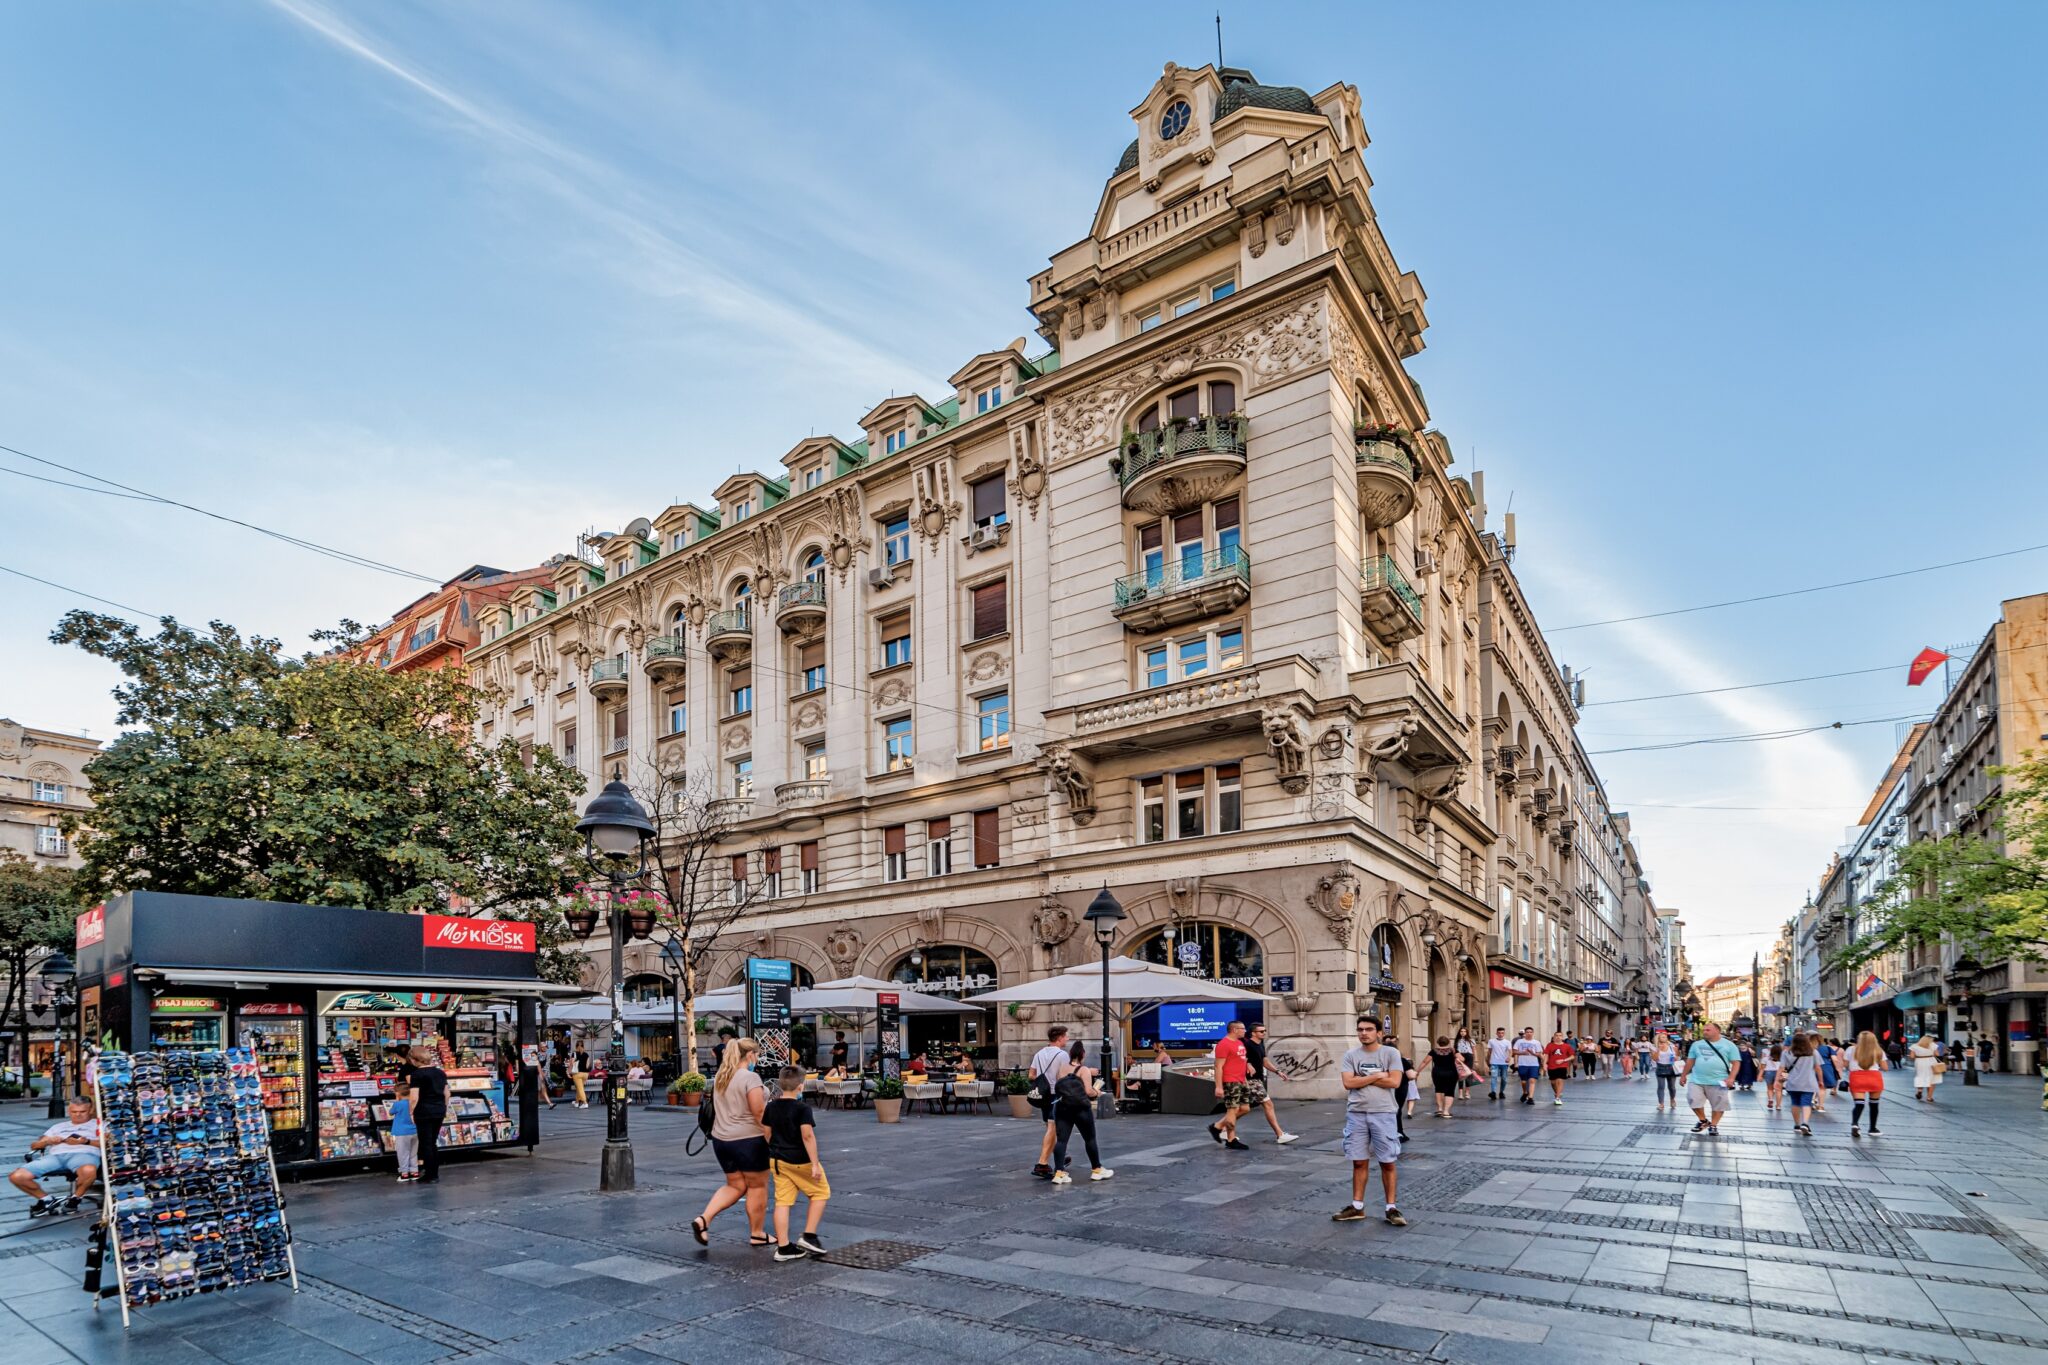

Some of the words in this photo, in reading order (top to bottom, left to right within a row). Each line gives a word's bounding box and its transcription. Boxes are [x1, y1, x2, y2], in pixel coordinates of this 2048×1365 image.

[437, 922, 468, 944] Moj
[470, 924, 523, 945] KIOSK
[1179, 969, 1206, 977] АНКА
[945, 974, 990, 991] ЦАР
[155, 999, 181, 1007] КЊАЗ
[182, 999, 215, 1007] МИЛОШ
